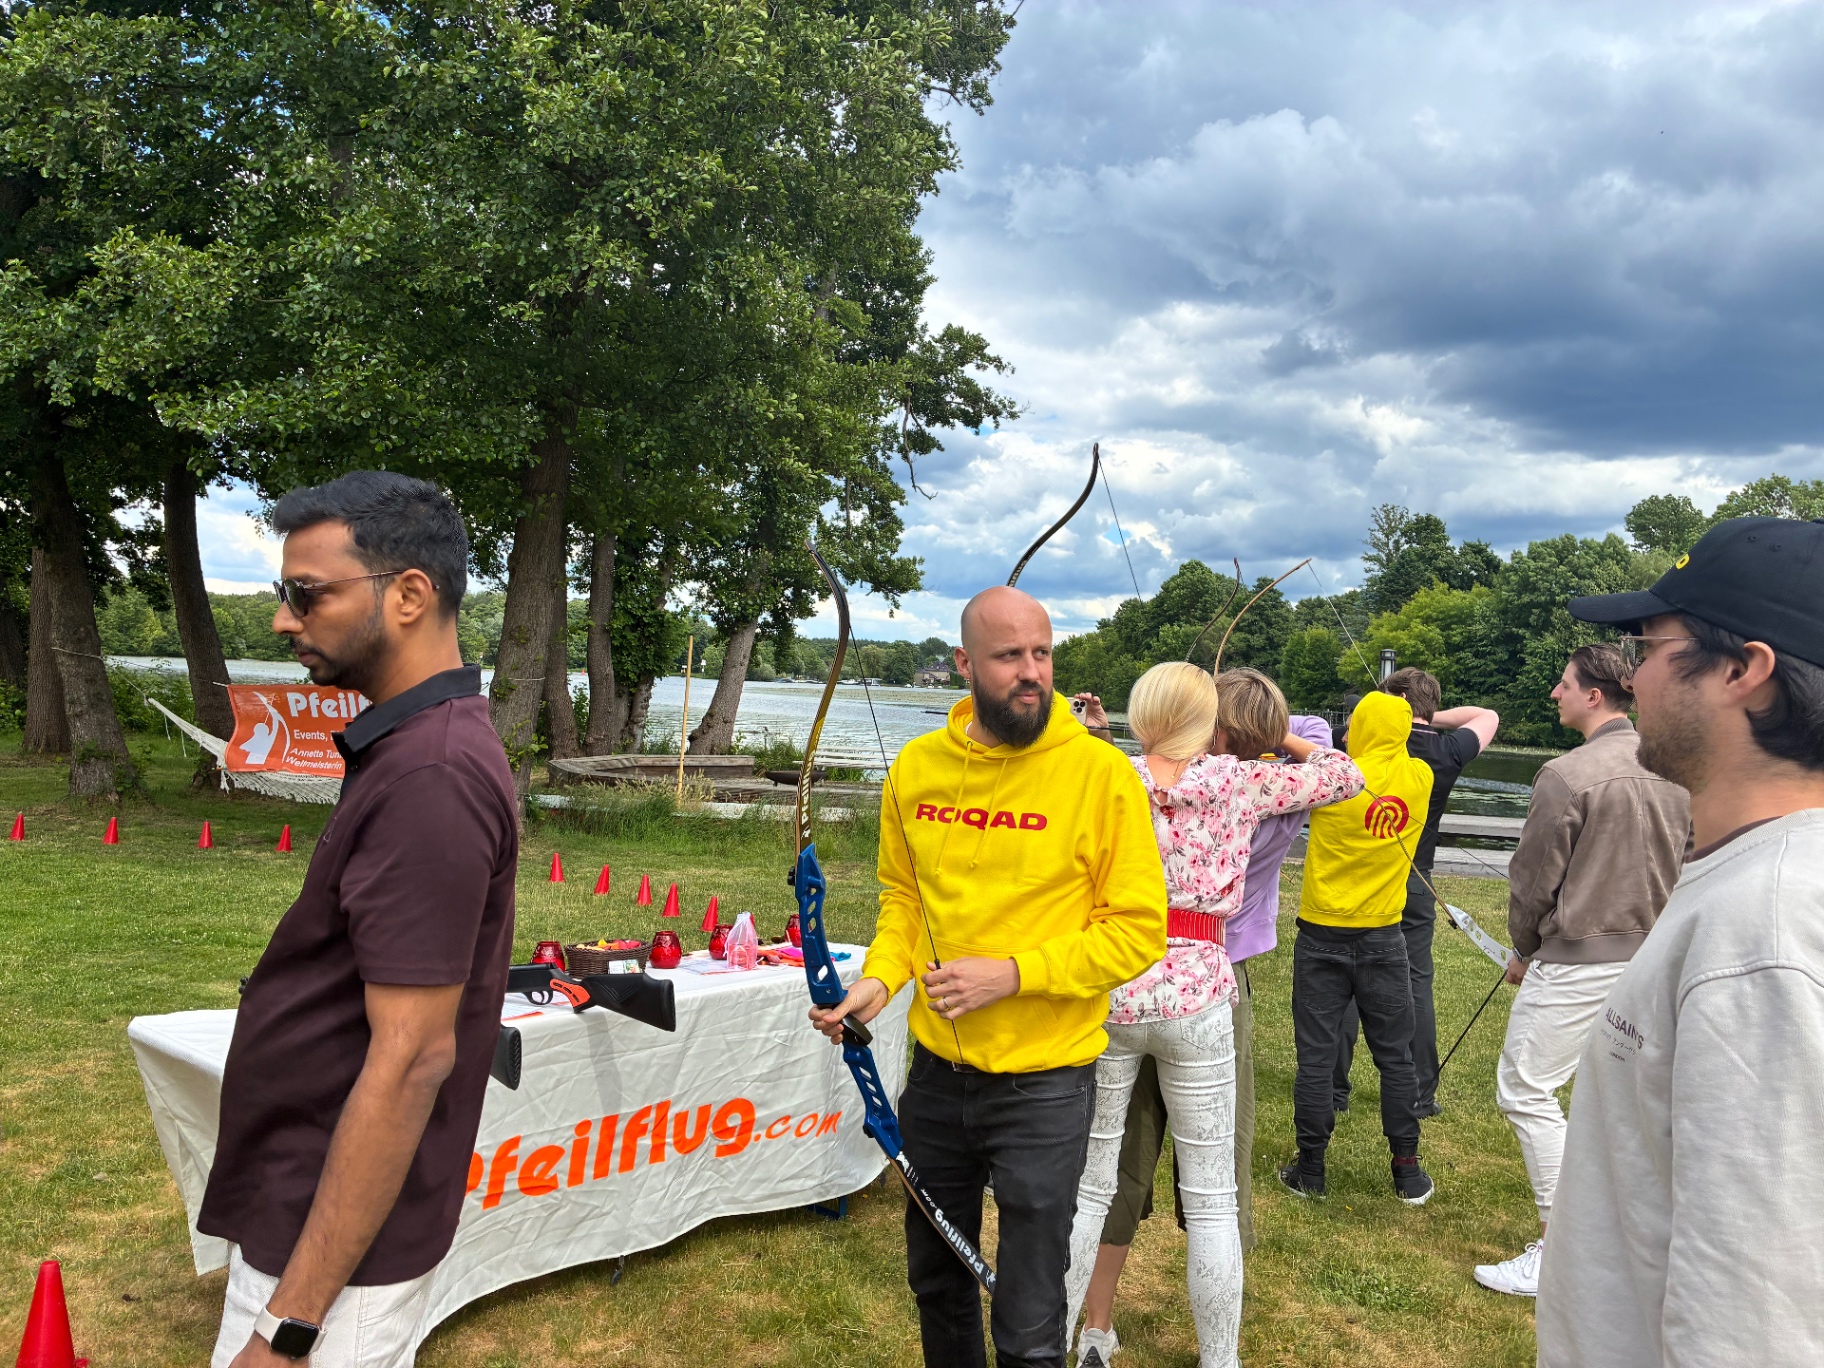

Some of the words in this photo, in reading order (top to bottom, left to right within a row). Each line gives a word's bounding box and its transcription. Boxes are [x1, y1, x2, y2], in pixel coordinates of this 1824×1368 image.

[294, 729, 328, 741] Events,
[290, 747, 324, 759] Annette
[915, 803, 1048, 831] ROQAD
[1605, 1007, 1645, 1050] ALLSAINS
